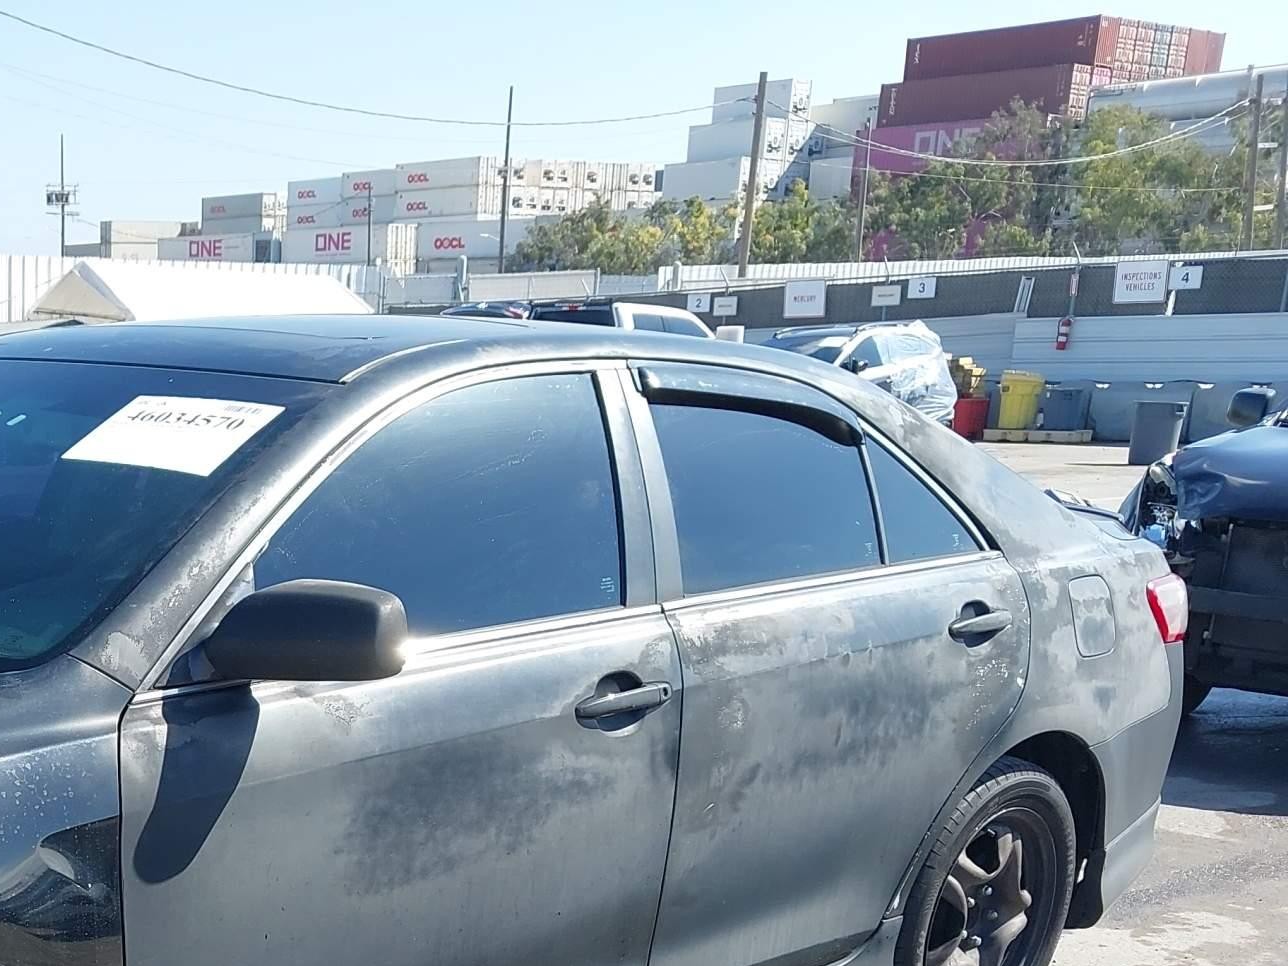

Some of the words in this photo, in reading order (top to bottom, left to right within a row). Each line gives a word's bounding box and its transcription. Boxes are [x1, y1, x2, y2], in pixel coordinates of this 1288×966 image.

[407, 174, 429, 183] OOCL
[297, 190, 316, 199] OOCL
[406, 201, 428, 211] OOCL
[315, 232, 352, 252] ONE
[434, 236, 465, 250] OOCL
[189, 239, 223, 257] ONE
[1121, 272, 1162, 281] INSPECTIONS
[1181, 272, 1190, 284] 4
[918, 282, 926, 293] 3
[1125, 282, 1155, 291] VEHICLES
[695, 298, 702, 308] 2
[127, 409, 245, 431] 46034570
